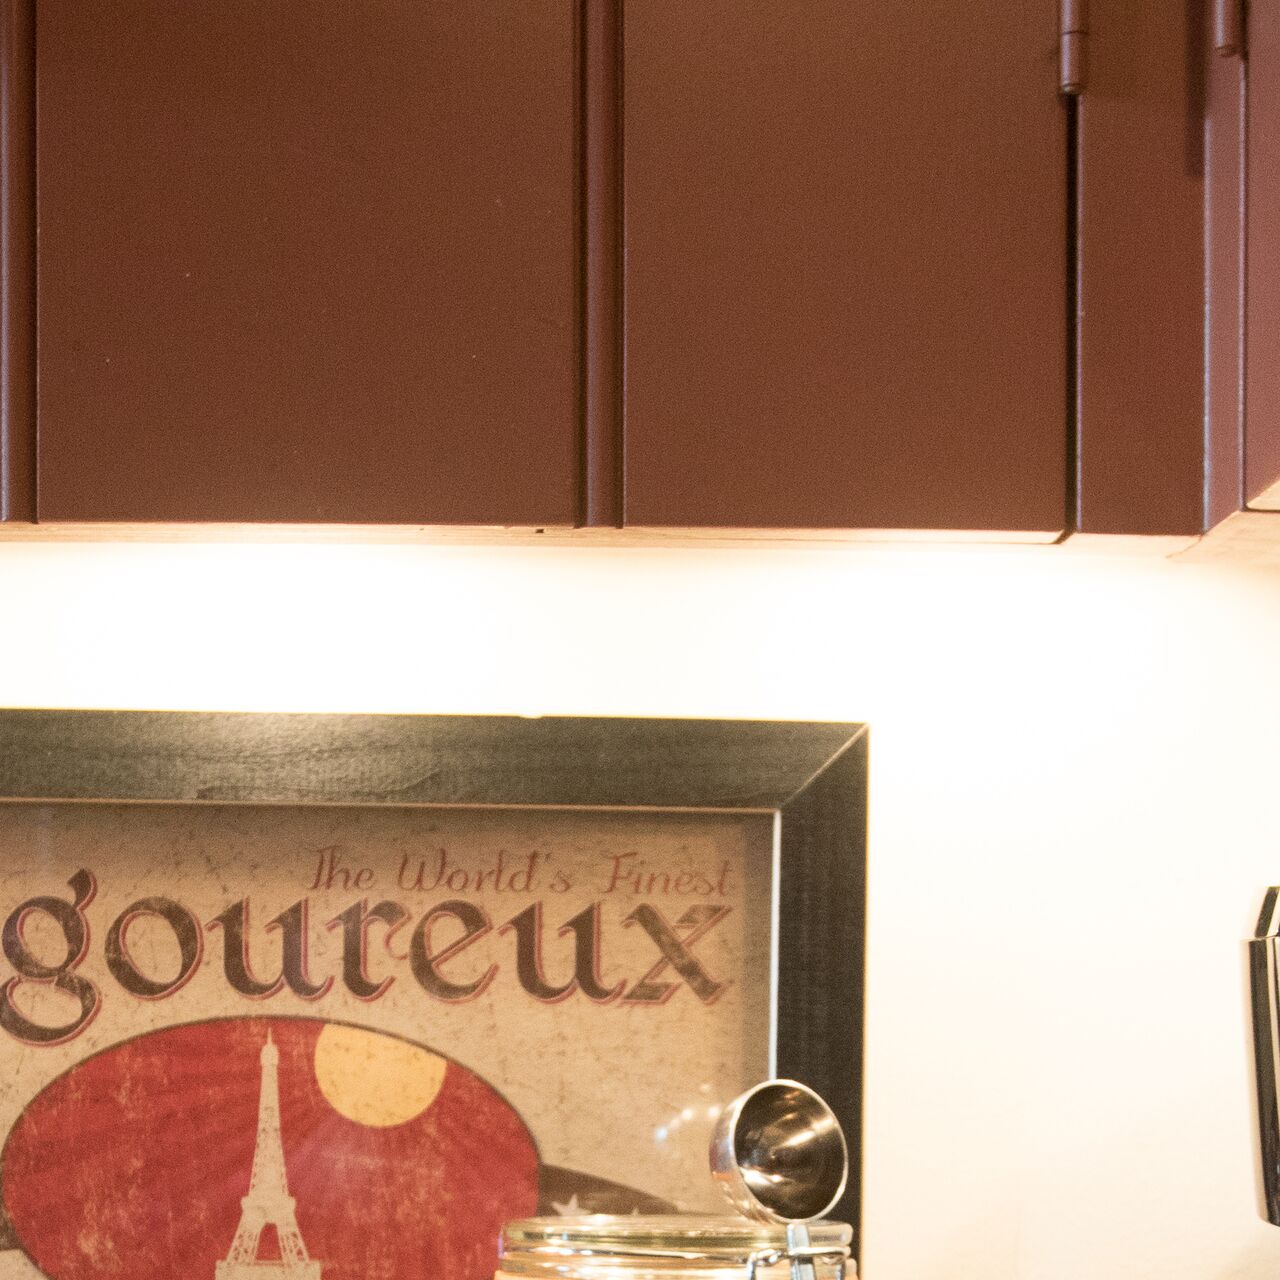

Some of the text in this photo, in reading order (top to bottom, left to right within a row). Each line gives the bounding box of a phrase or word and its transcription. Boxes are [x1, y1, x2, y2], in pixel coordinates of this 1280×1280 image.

[307, 846, 737, 897] The World's Finest
